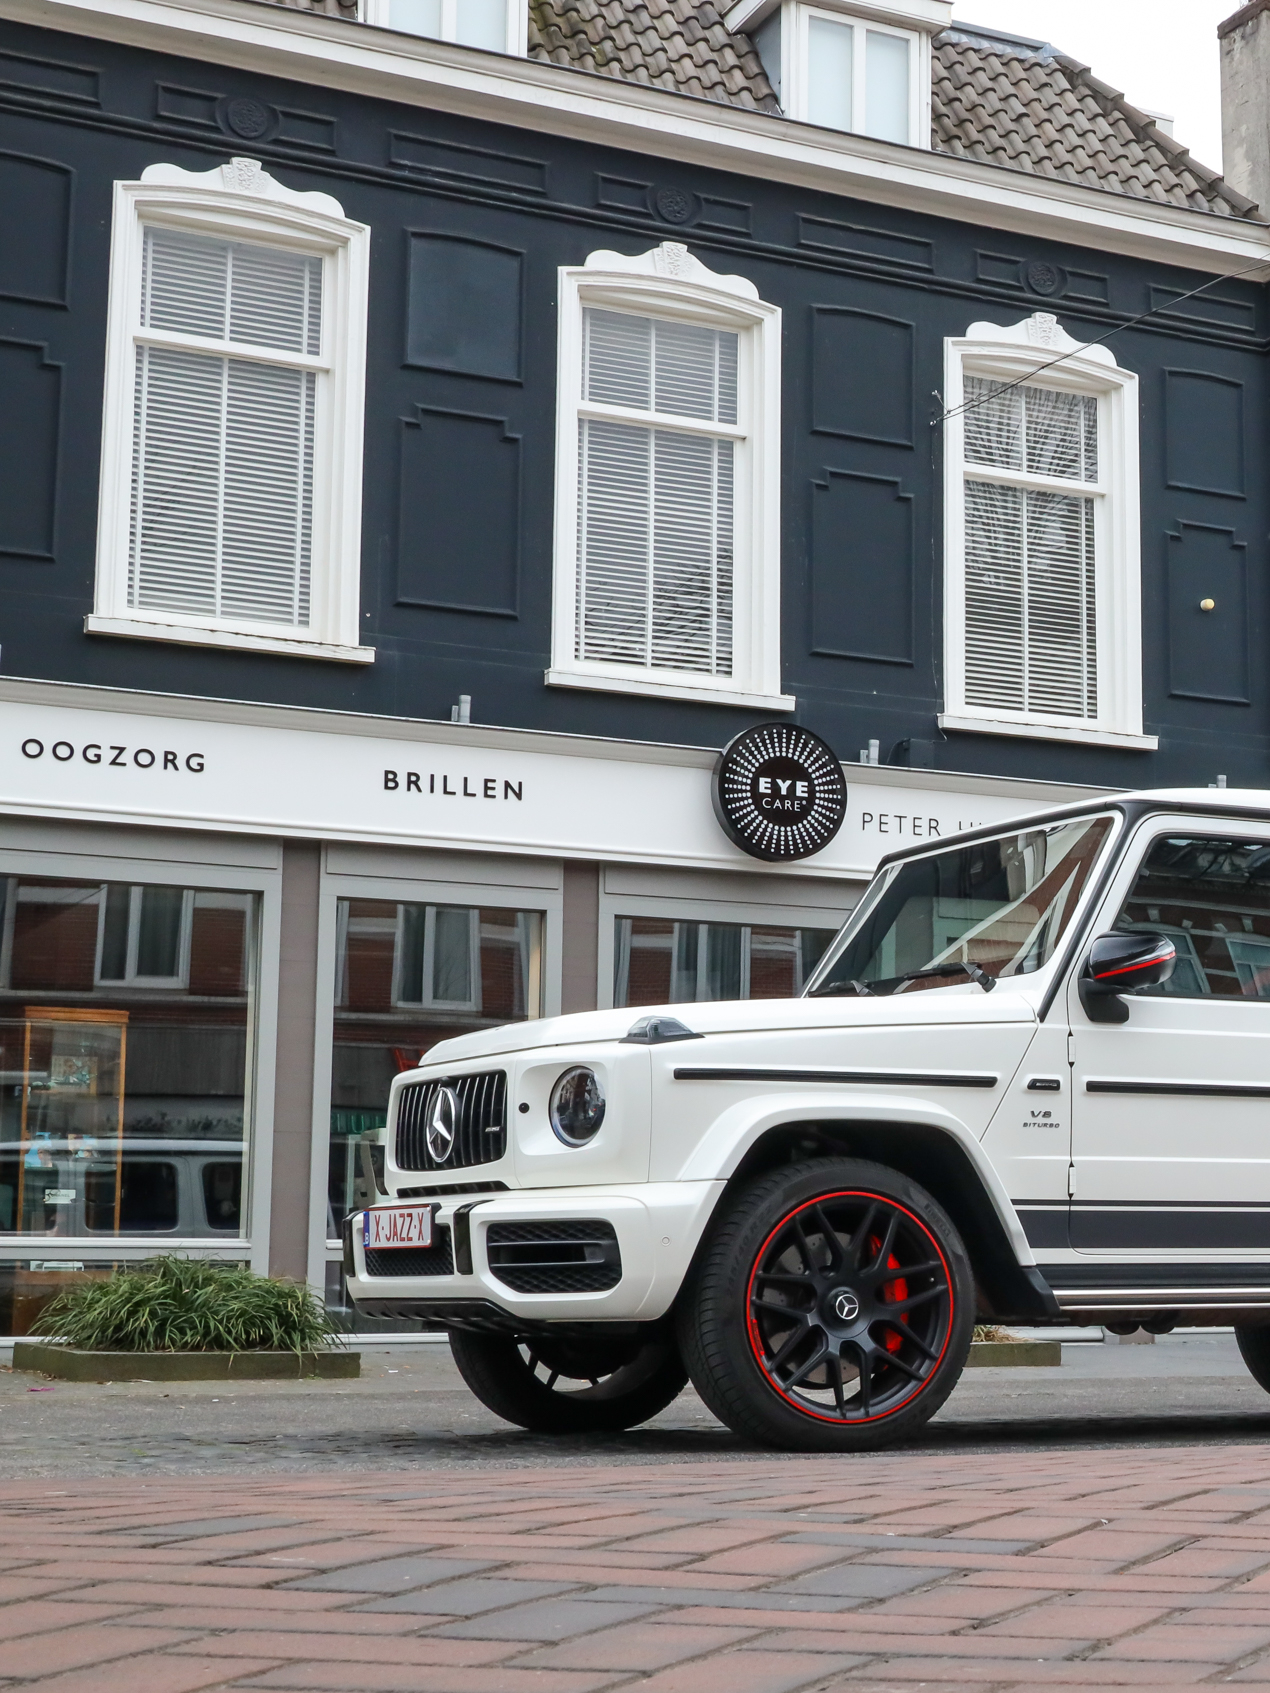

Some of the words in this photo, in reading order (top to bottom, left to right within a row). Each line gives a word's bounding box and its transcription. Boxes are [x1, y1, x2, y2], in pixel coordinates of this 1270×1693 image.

[21, 738, 205, 773] OOGZORG
[384, 769, 523, 801] BRILLEN
[758, 777, 809, 798] EYE
[862, 812, 941, 836] PETER
[1030, 1110, 1052, 1118] V8
